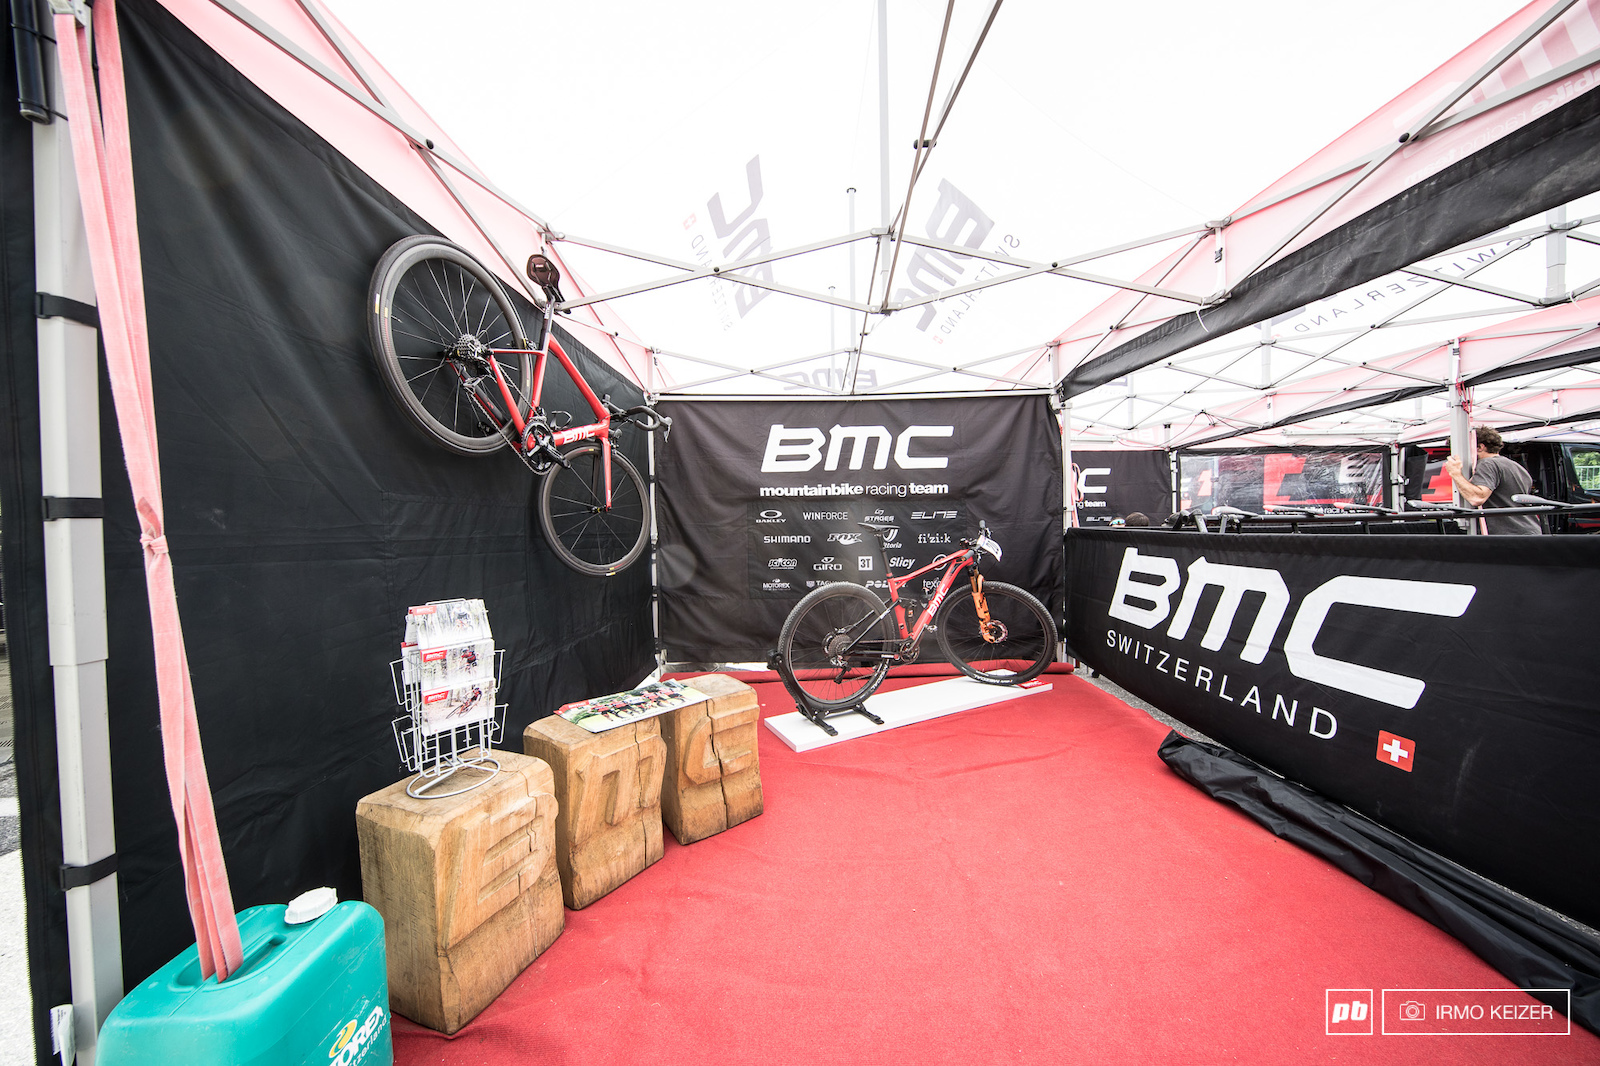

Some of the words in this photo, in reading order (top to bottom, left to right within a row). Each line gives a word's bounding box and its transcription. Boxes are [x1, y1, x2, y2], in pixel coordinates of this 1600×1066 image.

[562, 425, 596, 444] BMC
[761, 424, 954, 472] BMC
[760, 483, 864, 497] mountainbike
[865, 483, 907, 498] racing
[909, 483, 949, 495] team
[803, 511, 848, 520] WINFORCE
[911, 510, 958, 519] ELITE
[764, 535, 811, 543] SHIMANO
[827, 533, 862, 545] FOX
[813, 563, 843, 571] GIRO
[889, 556, 916, 569] Slicy
[927, 584, 949, 617] BMC
[1108, 547, 1477, 709] BMC
[1106, 629, 1339, 741] SWITZERLAND
[329, 1005, 384, 1066] OREX
